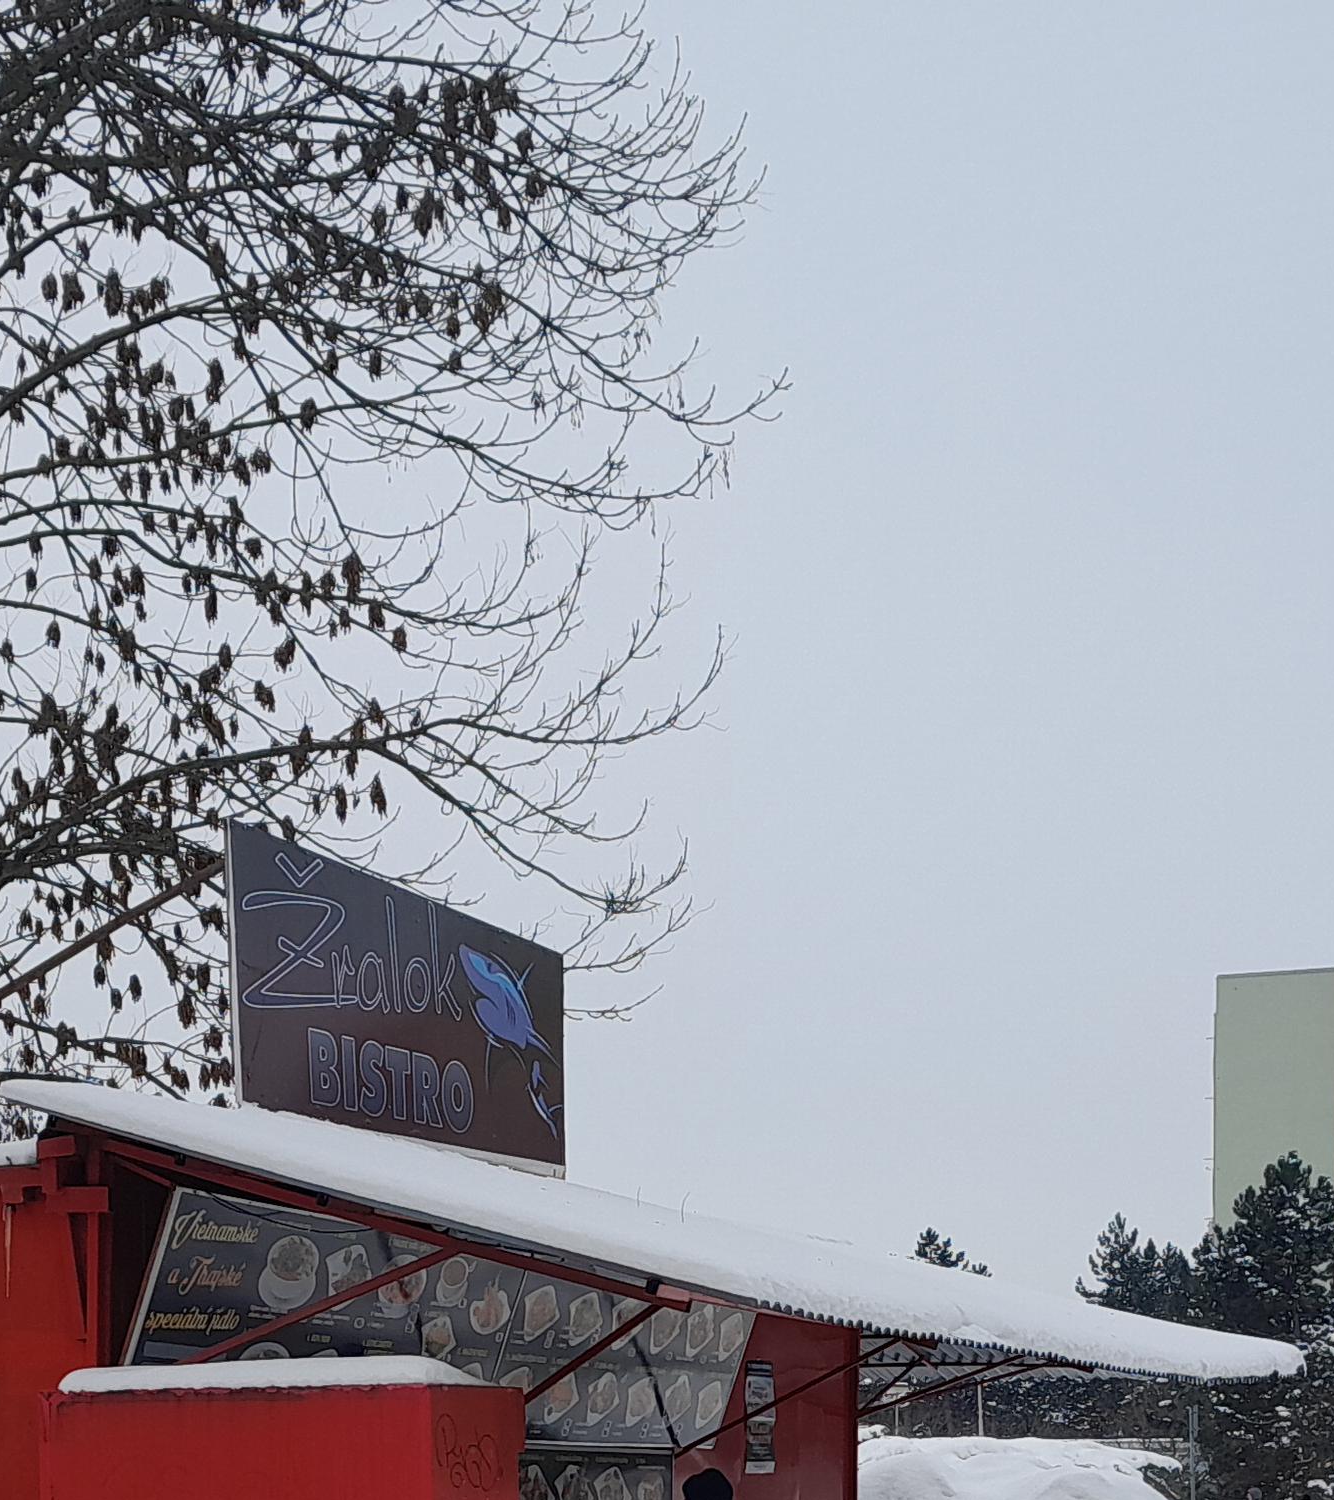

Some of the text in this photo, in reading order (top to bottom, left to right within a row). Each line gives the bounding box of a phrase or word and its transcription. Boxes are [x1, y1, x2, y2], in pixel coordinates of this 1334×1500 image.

[242, 852, 462, 1021] Žralok
[307, 1028, 474, 1133] BISTRO
[171, 1209, 261, 1250] Vietnamské
[168, 1256, 246, 1295] a Thajské
